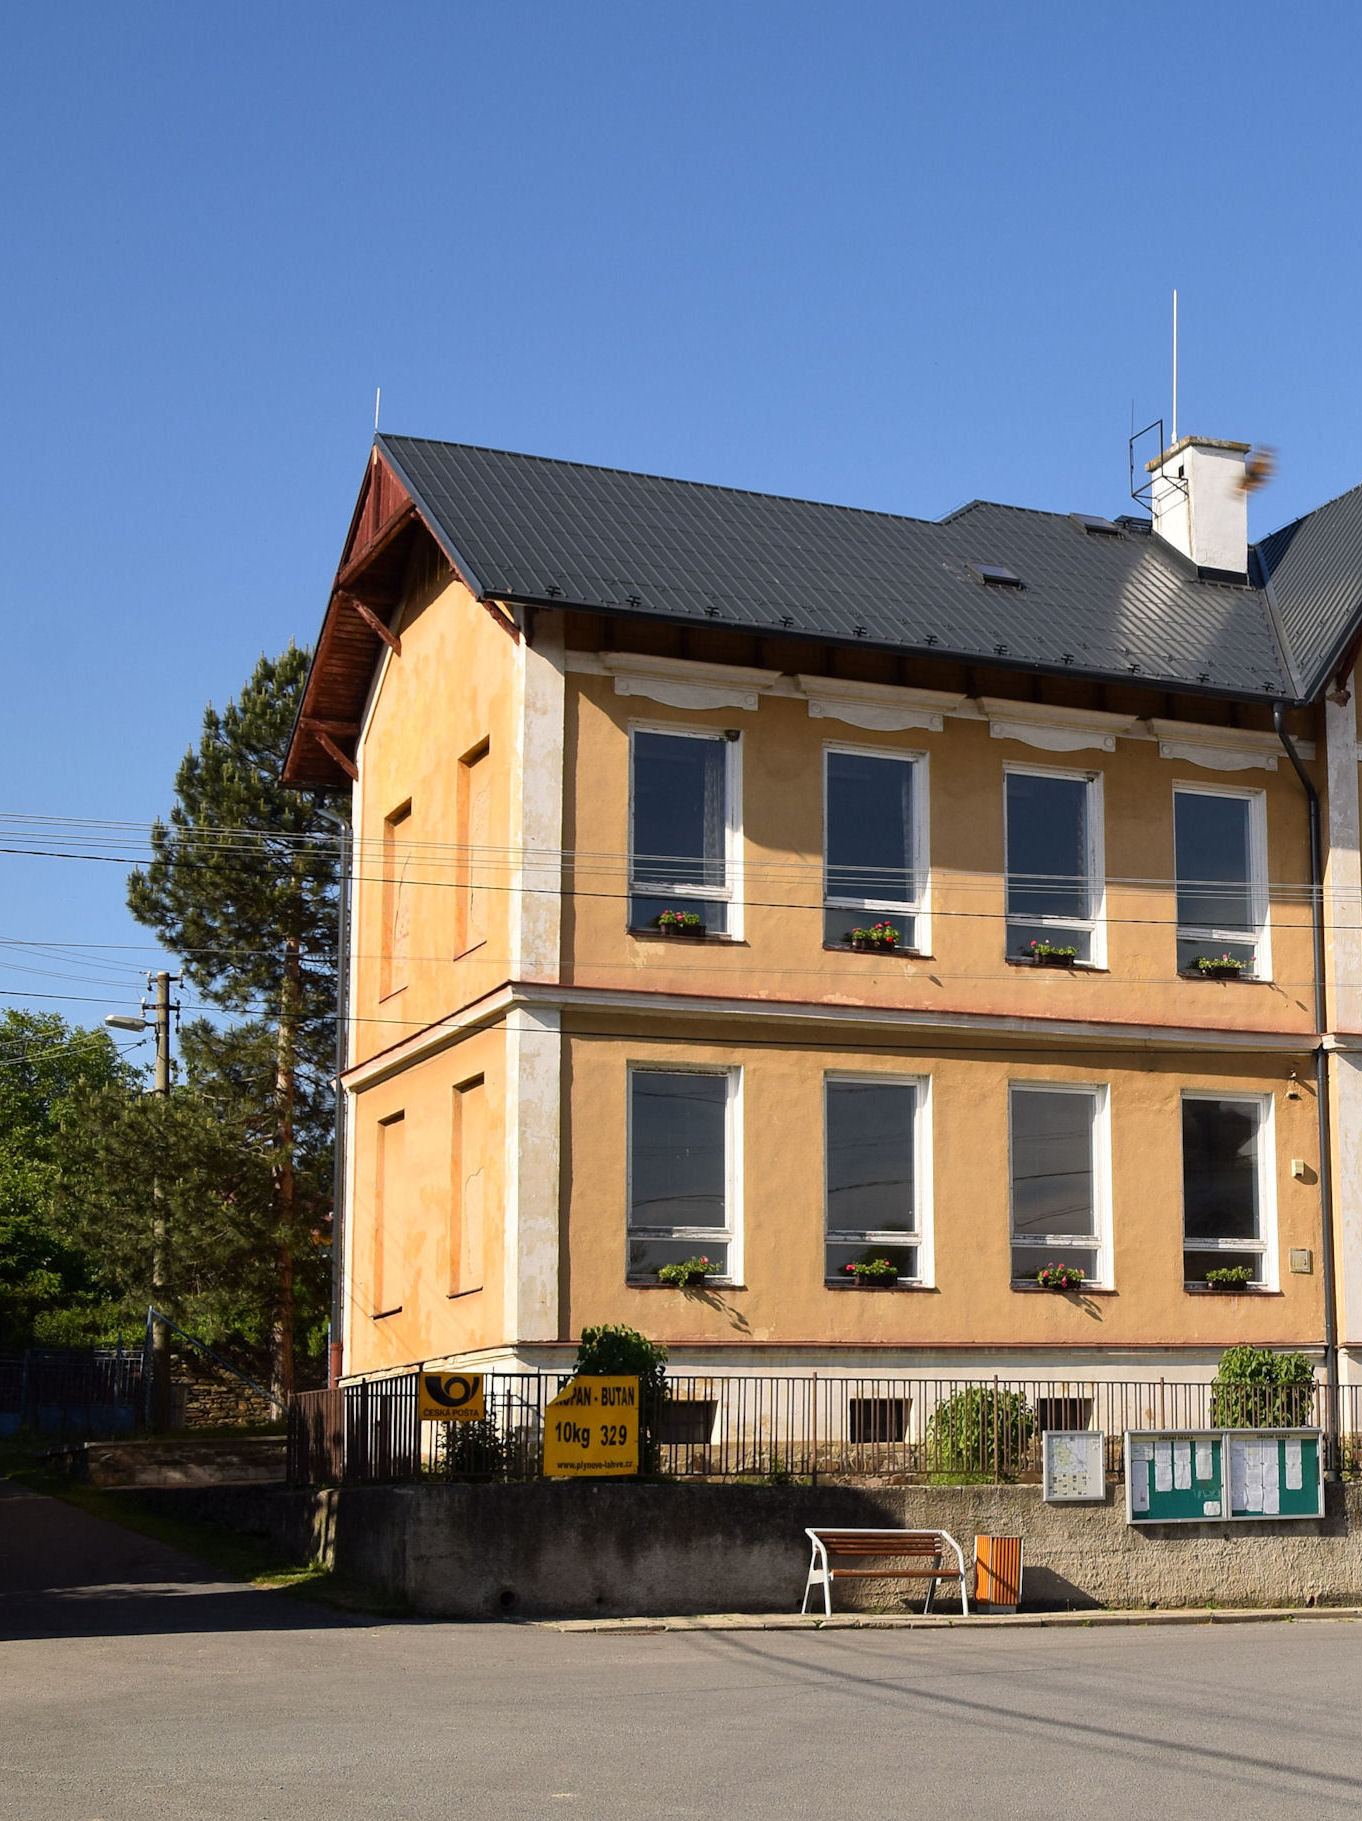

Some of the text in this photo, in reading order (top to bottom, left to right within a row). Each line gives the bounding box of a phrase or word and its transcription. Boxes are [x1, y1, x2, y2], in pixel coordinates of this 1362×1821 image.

[556, 1386, 592, 1406] PAN
[601, 1386, 635, 1406] BUTAN
[423, 1407, 479, 1417] ČESKÁ POŠTA
[555, 1421, 627, 1448] 10kg 329
